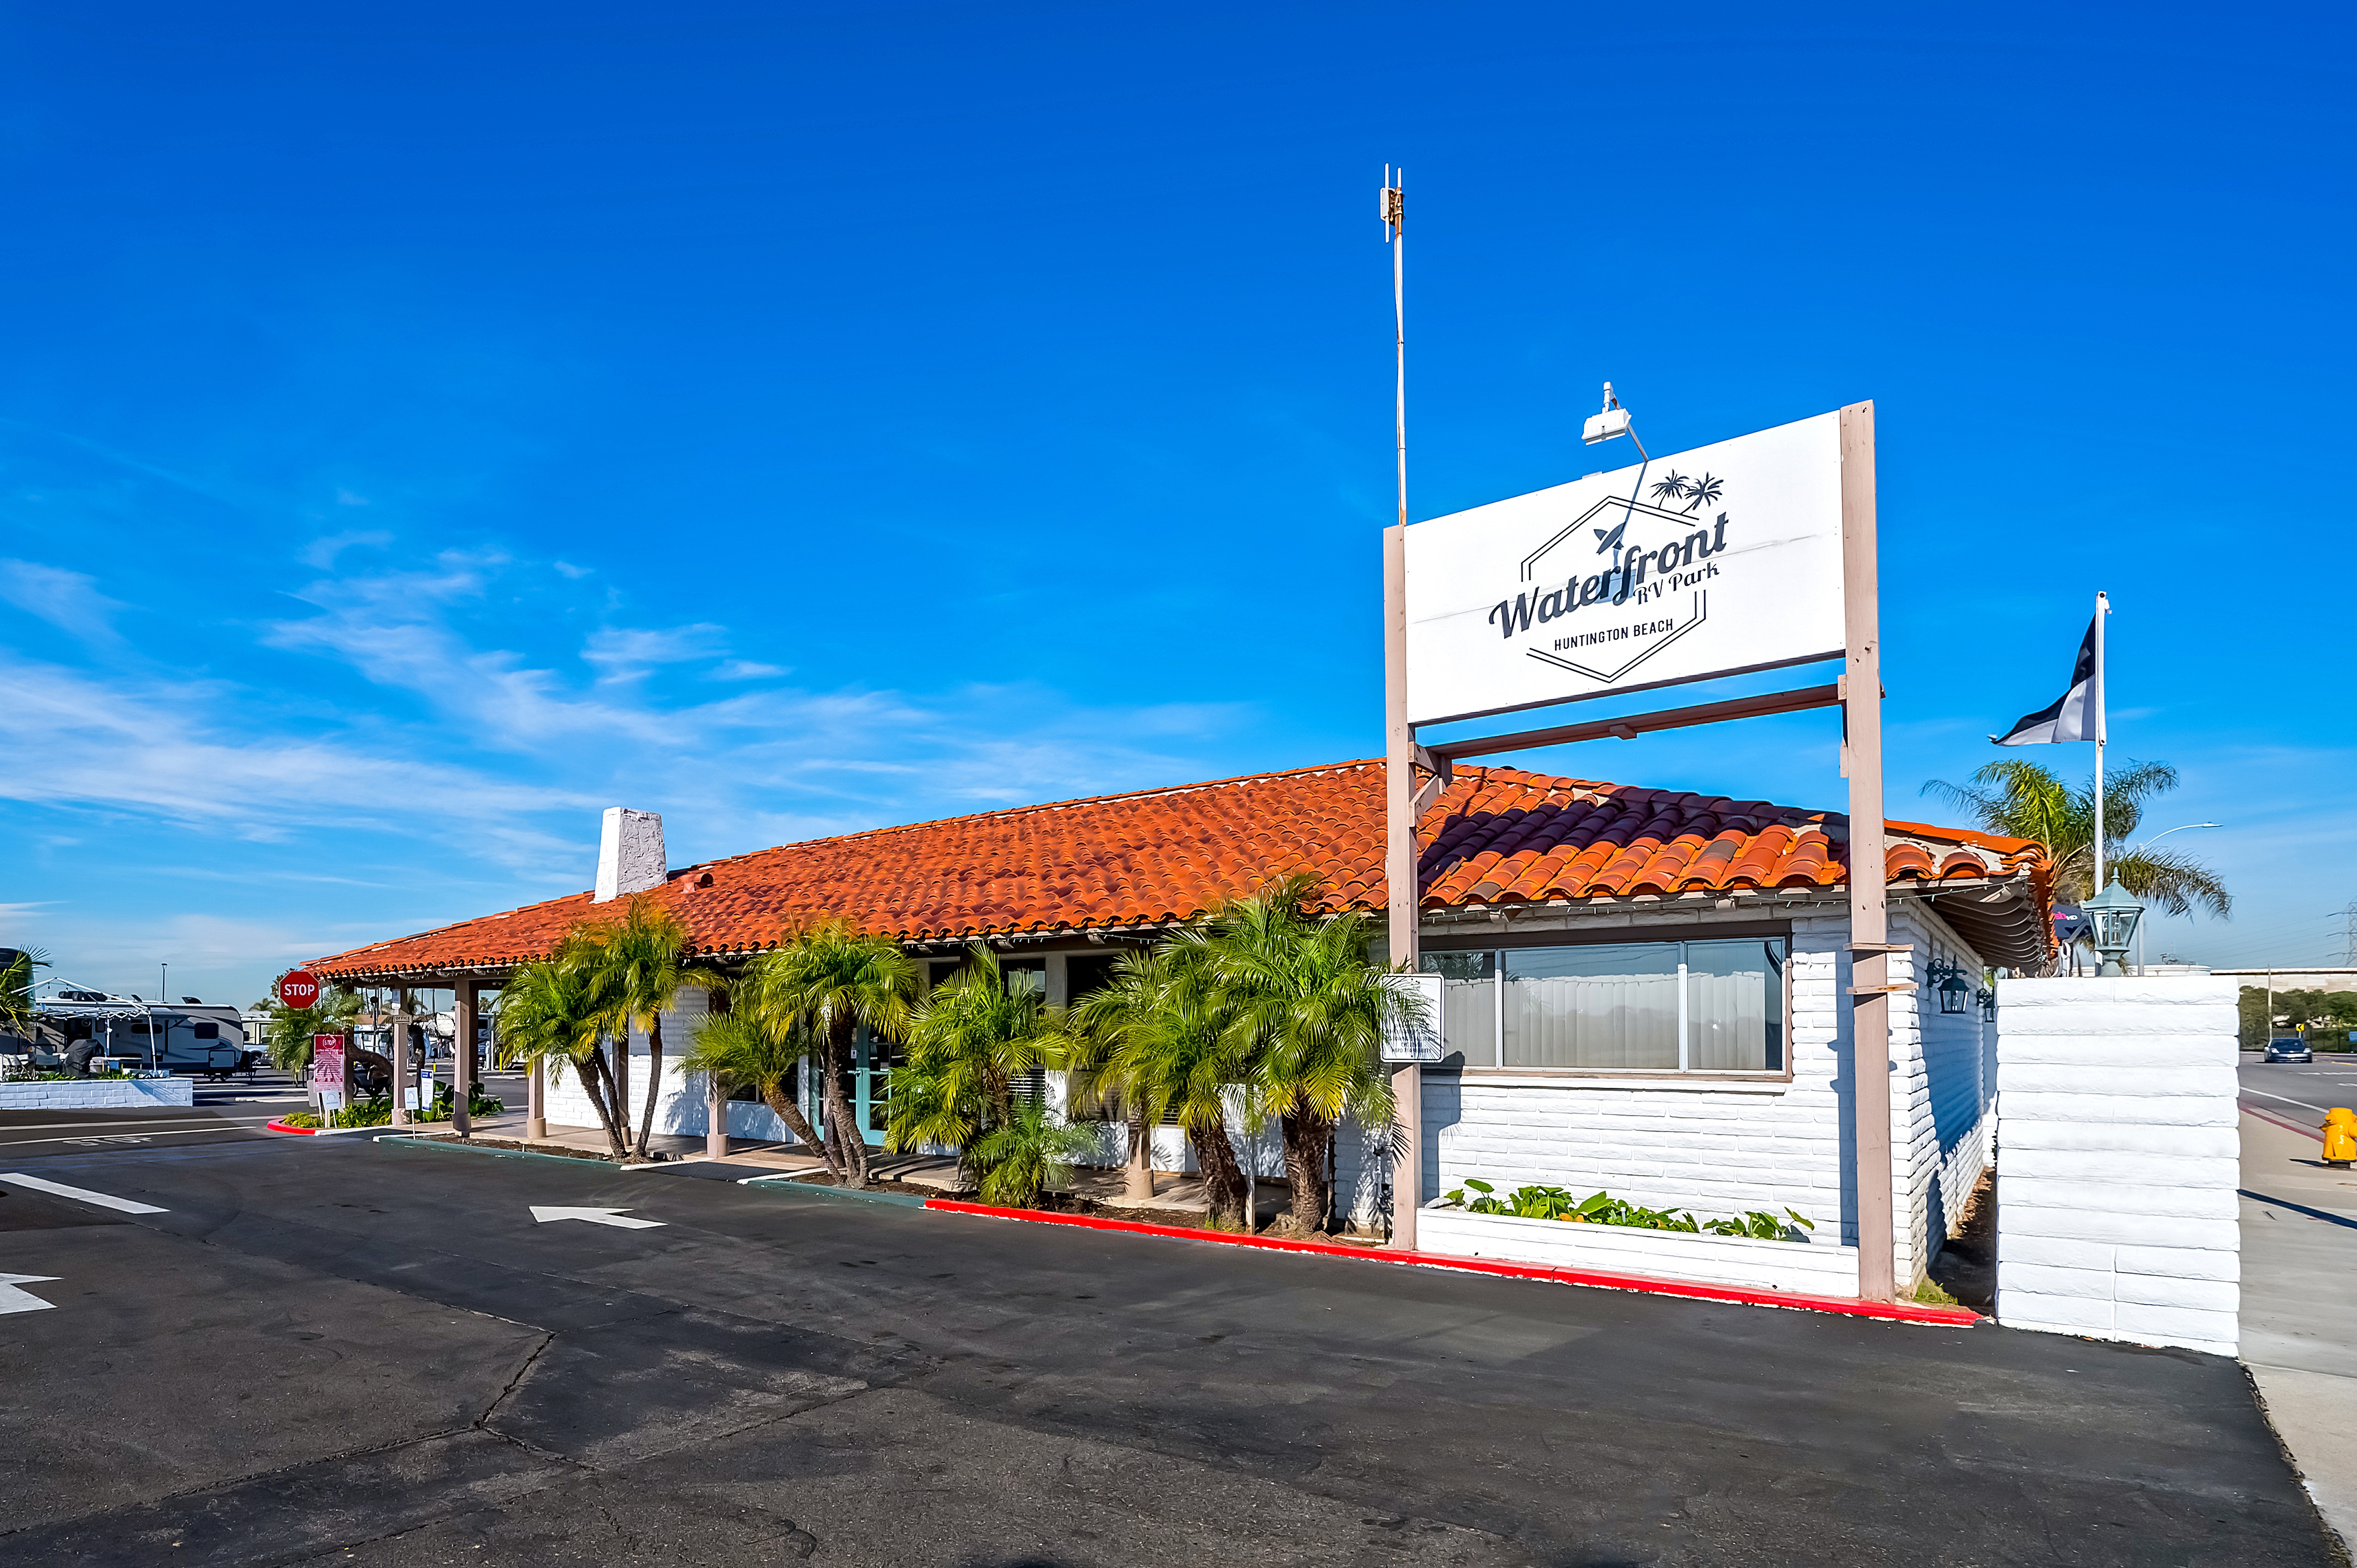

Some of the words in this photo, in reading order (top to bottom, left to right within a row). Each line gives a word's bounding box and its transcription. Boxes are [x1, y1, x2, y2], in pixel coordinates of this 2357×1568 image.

[1489, 511, 1729, 639] Waterfront
[1633, 579, 1664, 605] RV
[1668, 561, 1720, 592] Park
[1554, 626, 1628, 652] HUNTINGTON
[1633, 618, 1673, 637] BEACH
[284, 984, 315, 996] STOP
[62, 1136, 153, 1147] STOP
